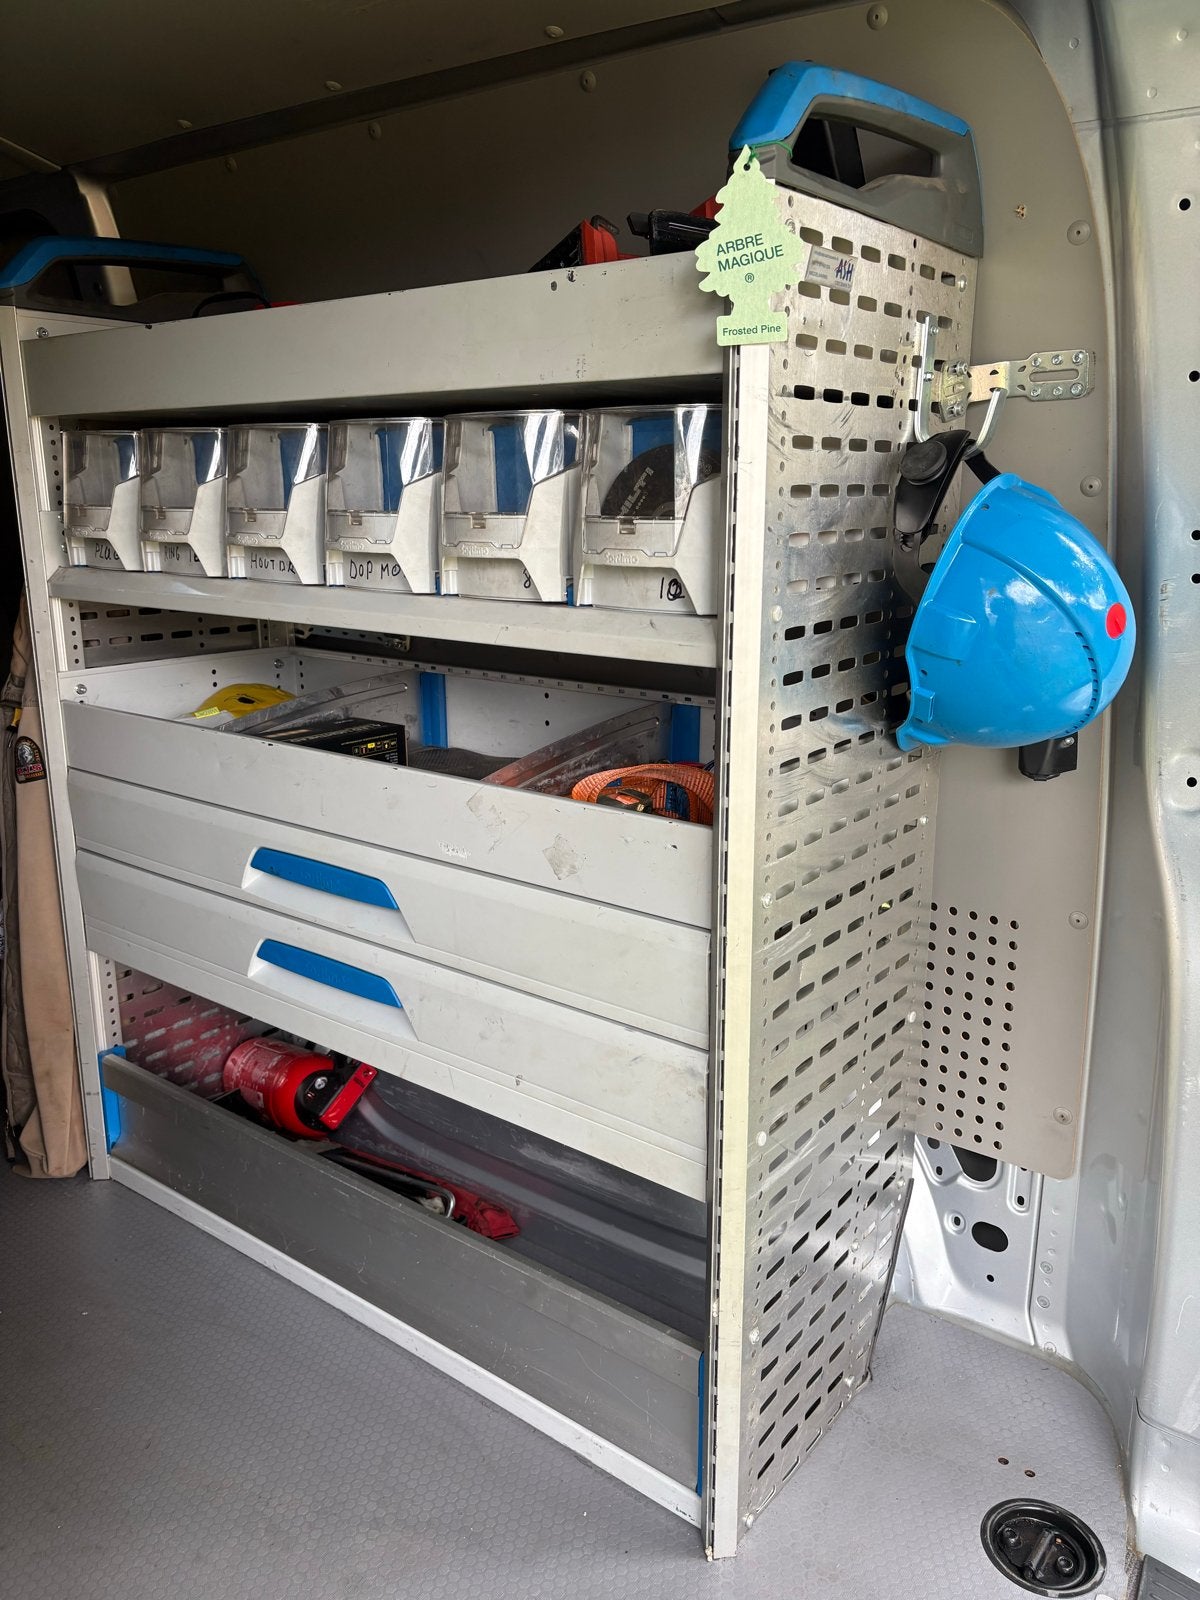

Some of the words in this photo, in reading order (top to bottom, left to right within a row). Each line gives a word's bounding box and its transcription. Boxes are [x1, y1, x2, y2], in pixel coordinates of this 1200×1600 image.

[716, 233, 764, 257] ARBRE
[717, 244, 785, 273] MAGIQUE
[834, 258, 854, 282] ASH
[722, 325, 758, 337] Frosted
[760, 324, 782, 334] Pine
[250, 552, 275, 570] HOUT
[349, 558, 373, 581] DOP
[380, 562, 406, 580] MO
